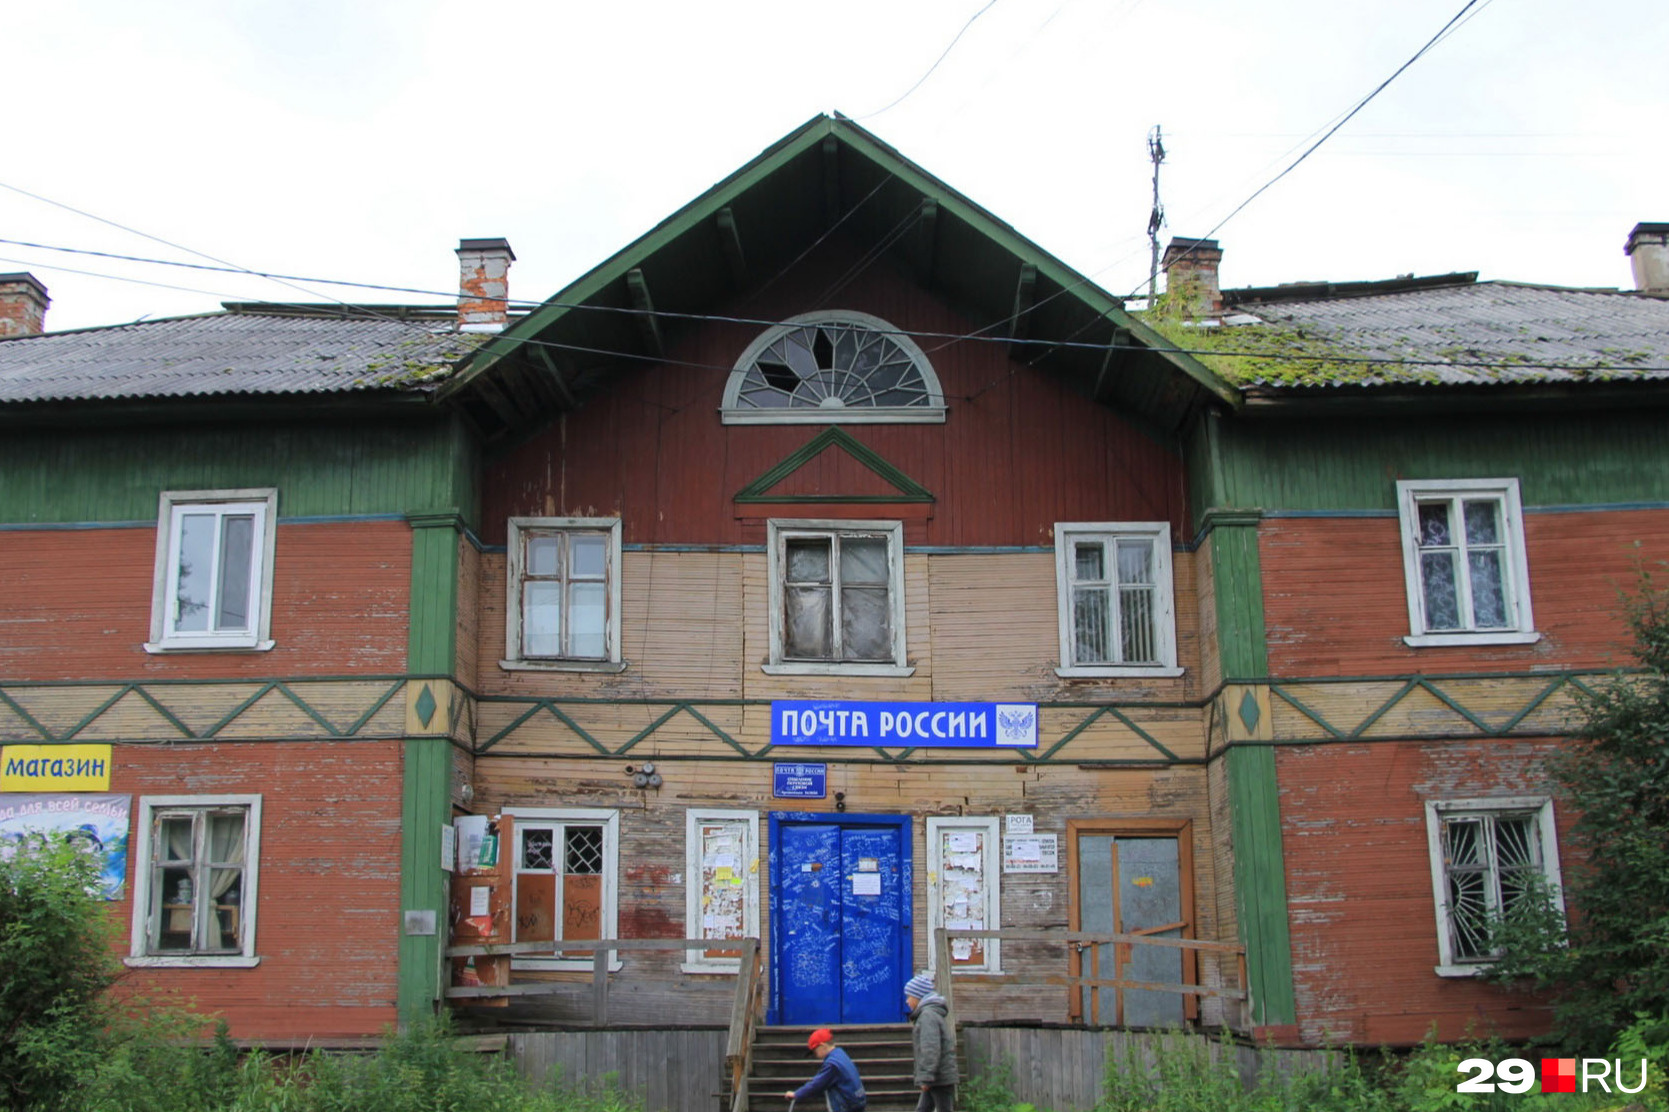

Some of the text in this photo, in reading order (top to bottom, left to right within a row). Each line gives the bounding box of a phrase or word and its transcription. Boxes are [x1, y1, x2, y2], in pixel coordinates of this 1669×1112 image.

[781, 709, 987, 738] ПОЧТА РОССИИ
[5, 758, 104, 778] магазин
[47, 797, 80, 812] всей
[84, 801, 128, 819] семьи
[1010, 816, 1032, 824] РОГА
